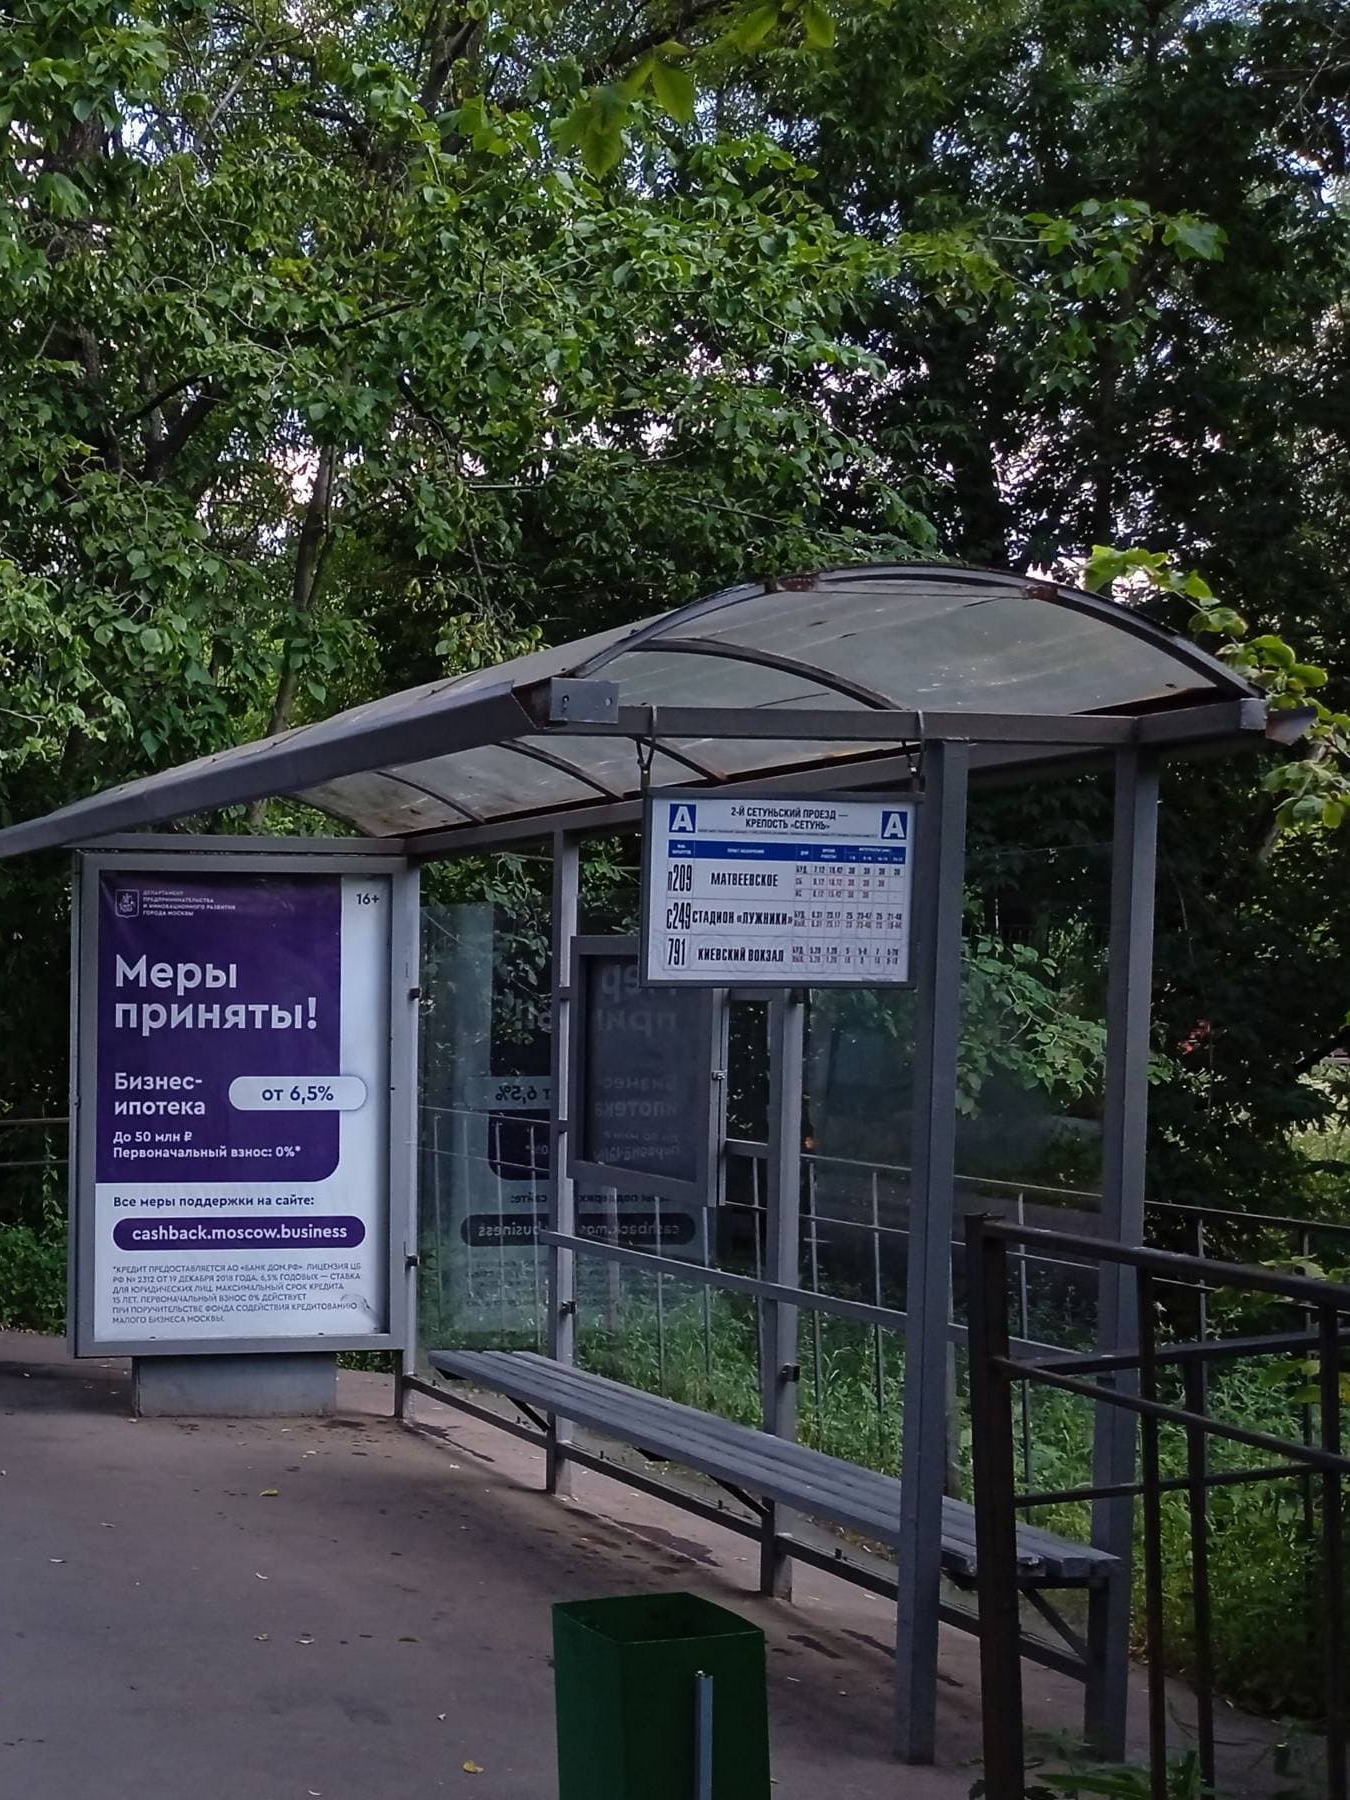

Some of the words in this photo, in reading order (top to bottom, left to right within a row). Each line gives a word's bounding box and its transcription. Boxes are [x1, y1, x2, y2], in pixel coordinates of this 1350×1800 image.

[671, 805, 694, 831] А
[730, 805, 745, 816] 2-Й
[746, 807, 801, 818] СЕТУНЬСКИЙ
[803, 810, 836, 820] ПРОЕЗД
[745, 818, 788, 829] КРЕПОСТЬ
[791, 820, 830, 830] «СЕТУНЬ»
[883, 813, 905, 838] А
[710, 872, 778, 887] МАТВЕЕВСКОЕ
[356, 893, 380, 905] 16+
[692, 910, 734, 925] СТАДИОН
[668, 938, 686, 966] 791
[698, 947, 746, 961] КИЕВСКИЙ
[748, 949, 784, 962] ВОКЗАЛ
[115, 954, 237, 996] Меры
[115, 997, 317, 1037] приняты!
[114, 1072, 203, 1090] Бизнес-
[262, 1089, 284, 1101] от
[290, 1085, 334, 1105] 6,5%
[114, 1101, 206, 1116] ипотека
[113, 1132, 132, 1144] До
[135, 1131, 151, 1142] 50
[155, 1133, 181, 1142] млн
[113, 1146, 227, 1160] Первоначальный
[231, 1148, 272, 1157] взнос:
[113, 1197, 136, 1207] Все
[140, 1198, 176, 1209] меры
[179, 1197, 253, 1209] поддержки
[257, 1197, 272, 1206] на
[275, 1194, 315, 1206] сайте:
[132, 1223, 348, 1241] cashback.moscow.business
[150, 1264, 225, 1273] ПРЕДОСТАВЛЯЕТСЯ
[306, 1263, 349, 1271] ЛИЦЕНЗИЯ
[138, 1275, 155, 1283] 2312
[178, 1275, 214, 1283] ДЕКАБРЯ
[280, 1273, 319, 1281] ГОДОВЫХ
[112, 1286, 129, 1294] ДЛЯ
[131, 1285, 193, 1293] ЮРИДИЧЕСКИХ
[216, 1283, 284, 1292] МАКСИМАЛЬНЫЙ
[309, 1283, 345, 1291] КРЕДИТА
[140, 1294, 217, 1303] ПЕРВОНАЧАЛЬНЫЙ
[262, 1292, 307, 1302] ДЕЙСТВУЕТ
[131, 1305, 203, 1313] ПОРУЧИТЕЛЬСТВЕ
[205, 1304, 234, 1313] ФОНДА
[236, 1302, 290, 1312] СОДЕЙСТВИЯ
[148, 1315, 186, 1323] БИЗНЕСА
